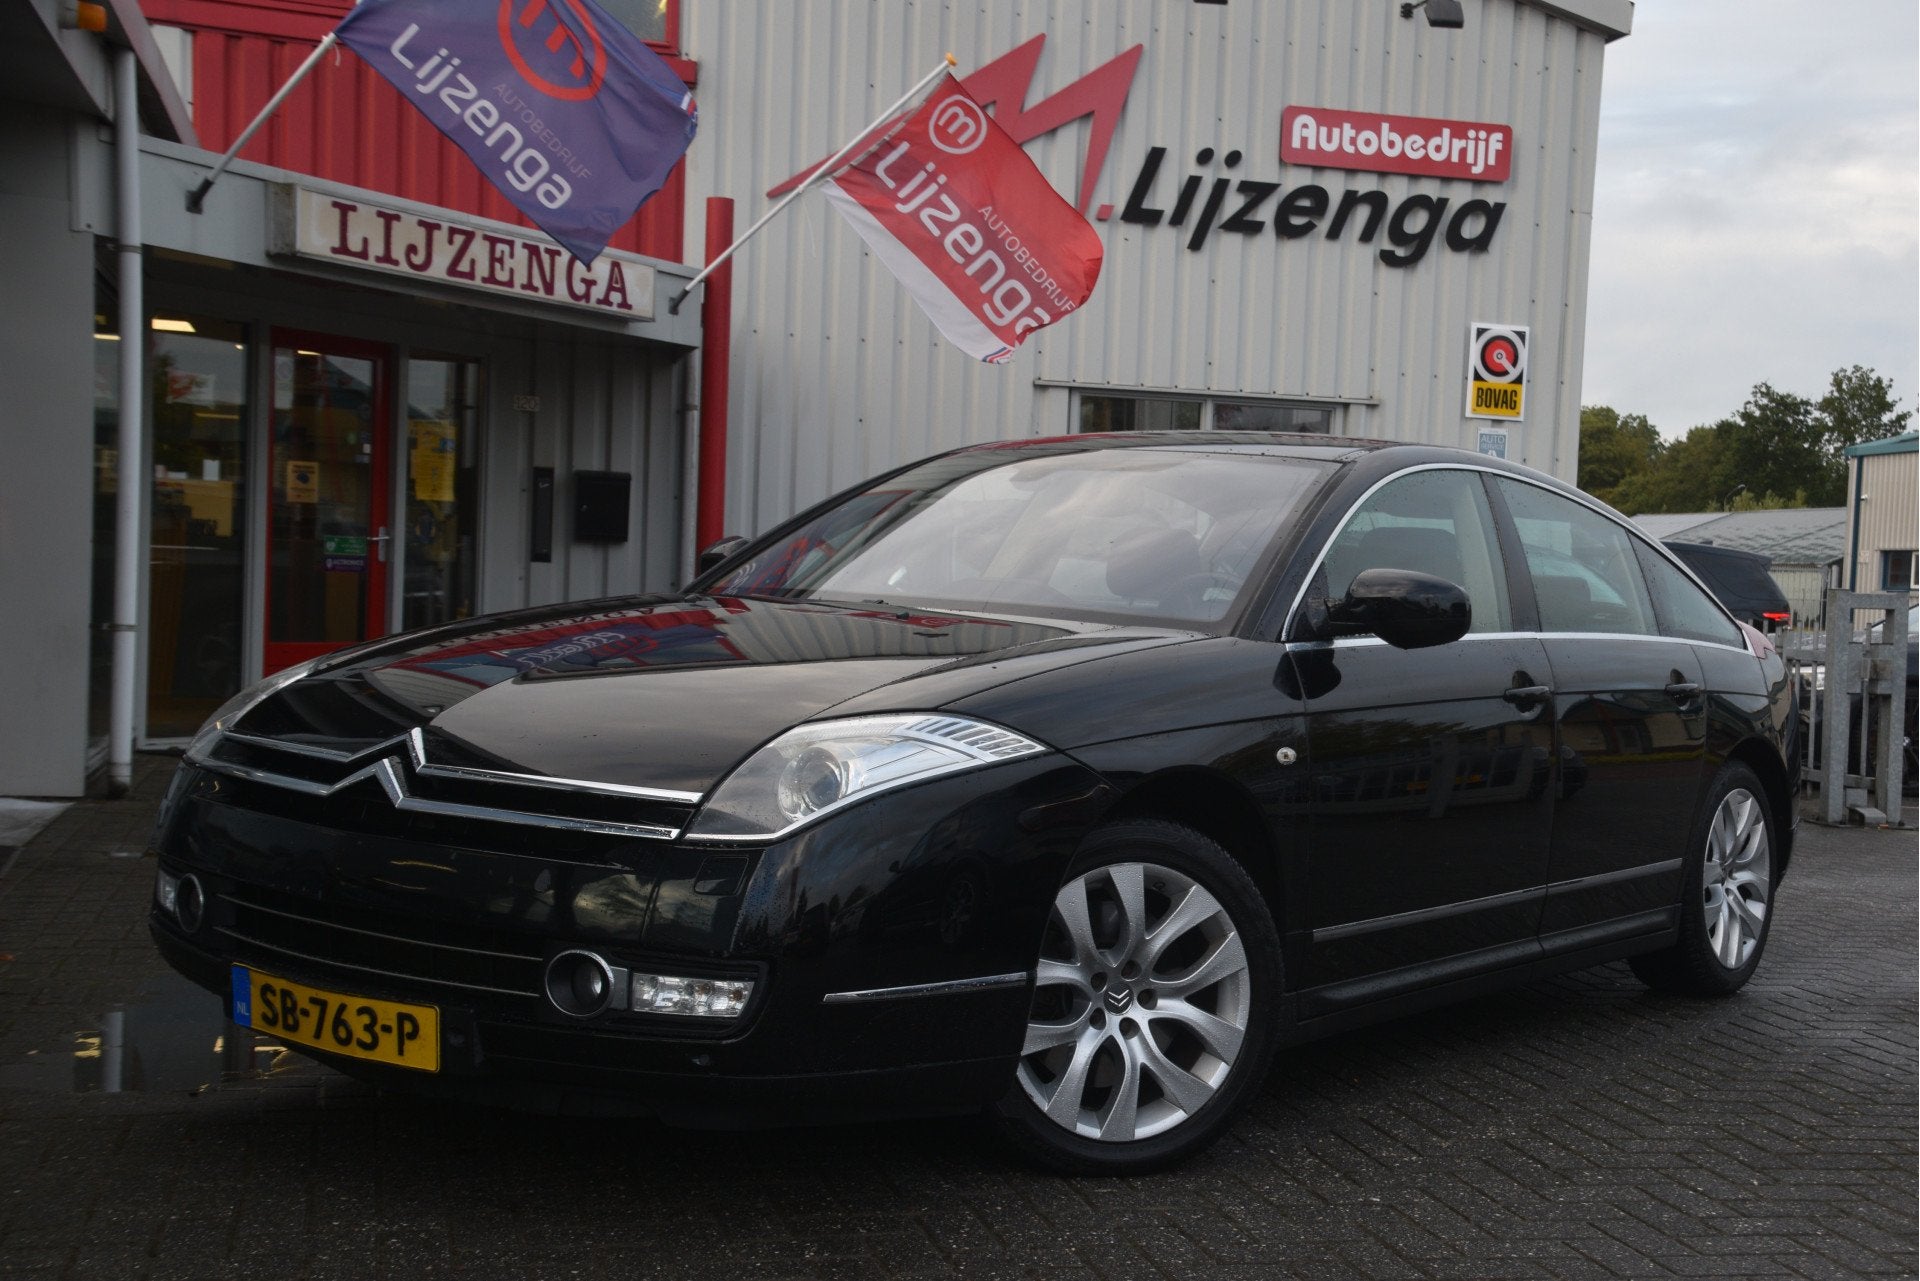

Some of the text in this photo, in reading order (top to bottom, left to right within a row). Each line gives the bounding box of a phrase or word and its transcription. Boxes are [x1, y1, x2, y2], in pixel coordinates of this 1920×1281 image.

[390, 22, 572, 209] Lijzenga
[493, 83, 592, 180] AUTOBEDRIJF
[1291, 113, 1505, 175] Autobedrijf
[1121, 146, 1506, 267] Lijzenga
[330, 201, 633, 310] LIJZENGA
[978, 205, 1077, 313] AUTOBEDRIJF
[1476, 387, 1517, 410] BOVAG
[1481, 435, 1504, 443] AUTO
[236, 983, 420, 1057] NL SB-763-P
